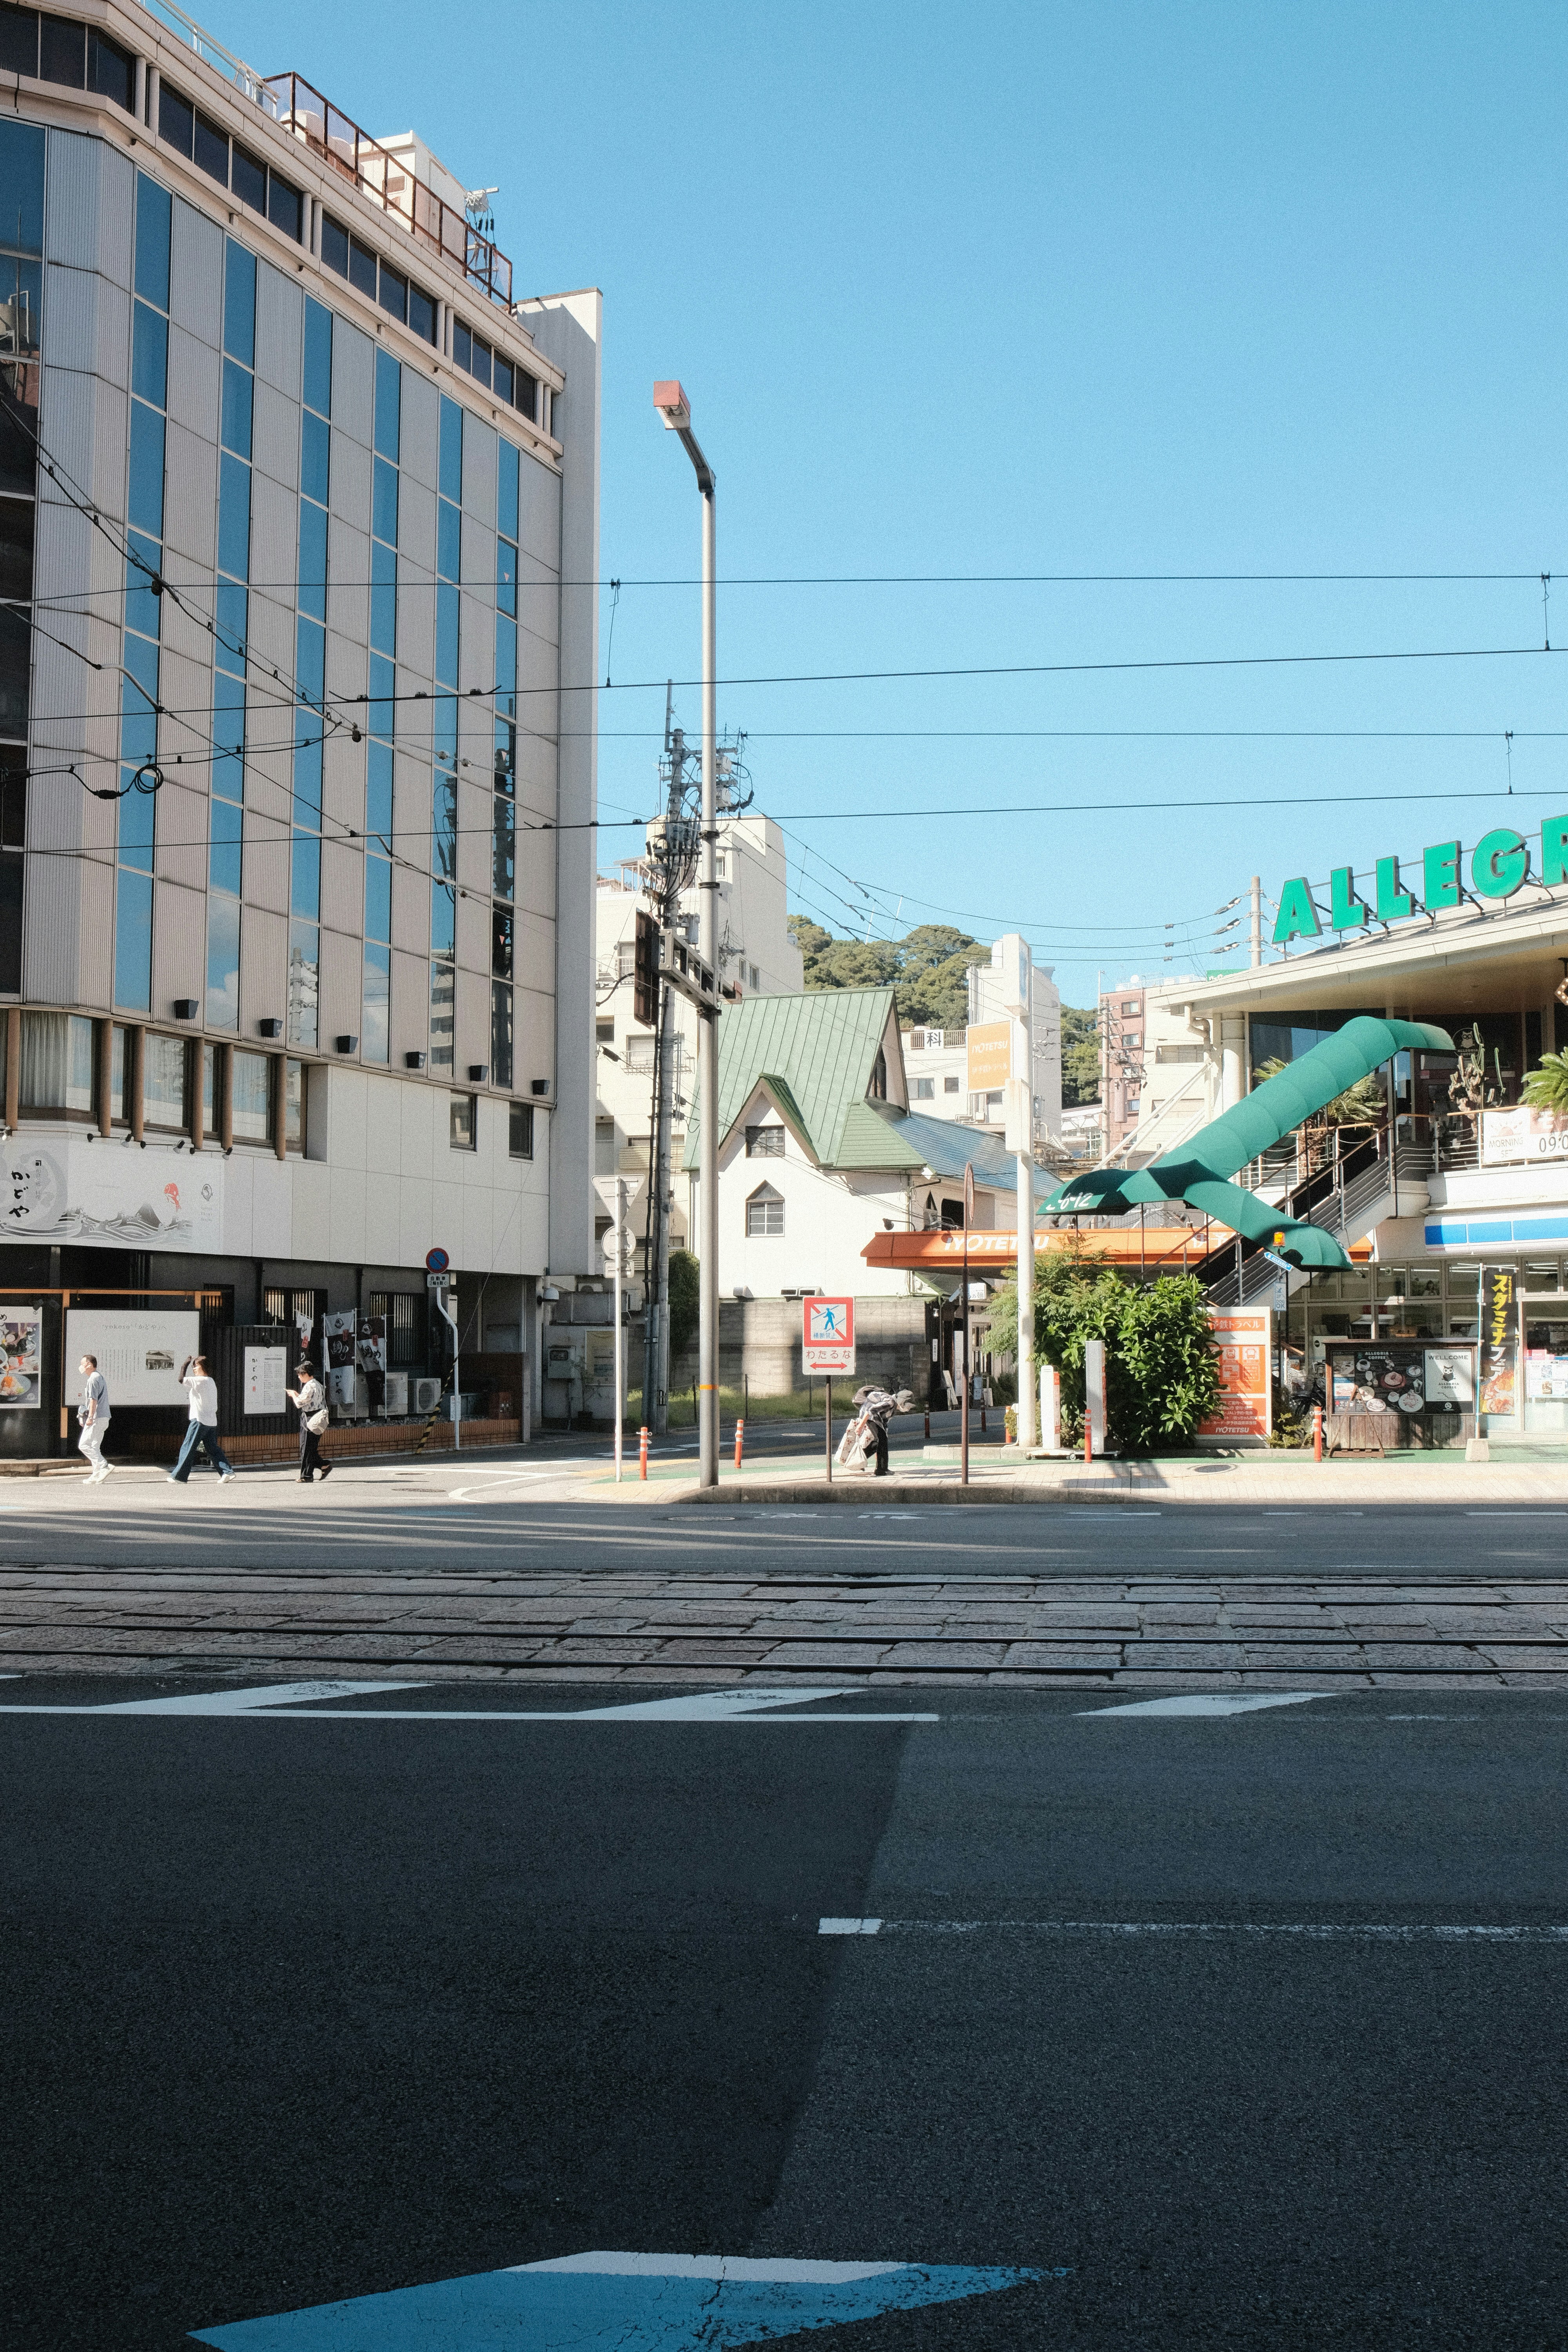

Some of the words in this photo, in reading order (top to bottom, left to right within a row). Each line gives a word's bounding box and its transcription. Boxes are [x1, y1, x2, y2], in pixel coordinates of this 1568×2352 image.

[927, 1032, 941, 1047] 科
[972, 1040, 1008, 1054] IYOTETSU
[1489, 1137, 1523, 1147] MORNING
[1501, 1149, 1513, 1158] SET
[9, 1170, 30, 1218] かどや
[944, 1234, 1050, 1252] IYOTETU
[1489, 1274, 1508, 1381] スタミナフェア
[806, 1350, 851, 1359] わたるな
